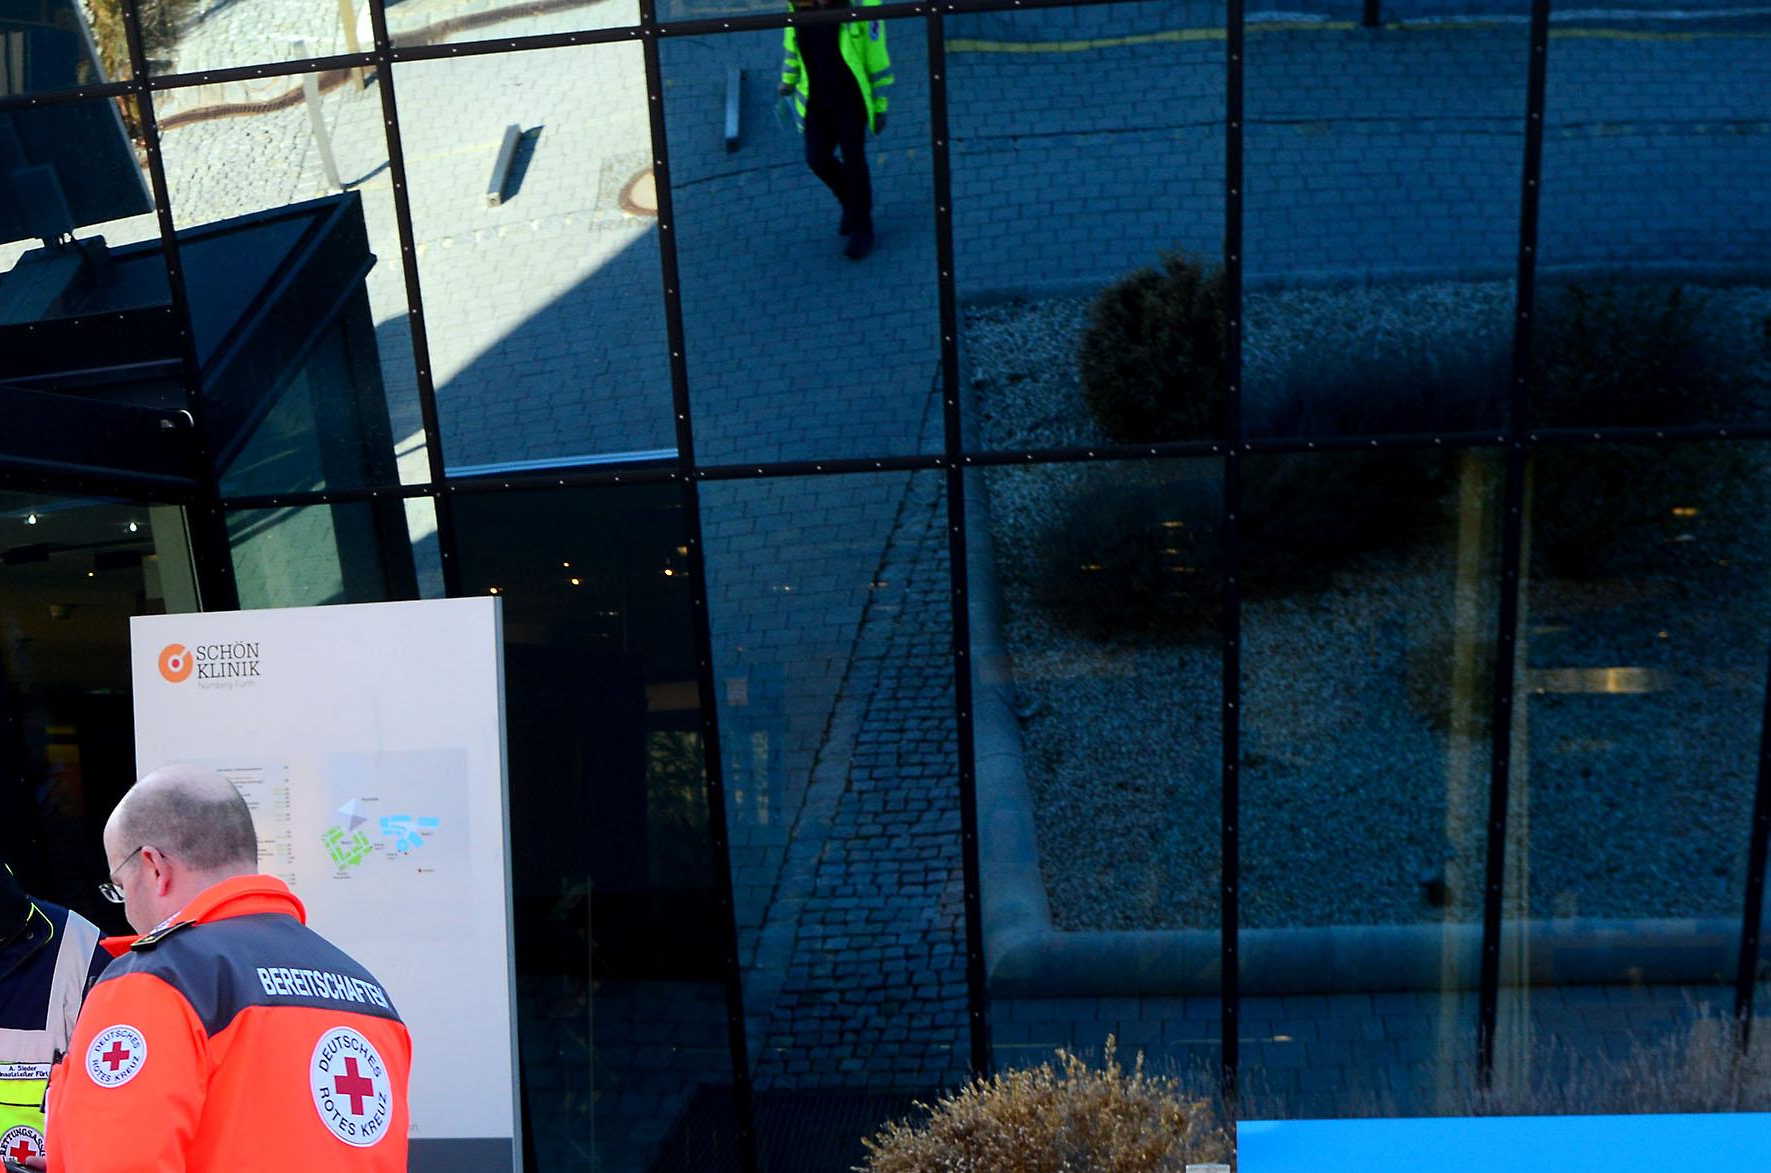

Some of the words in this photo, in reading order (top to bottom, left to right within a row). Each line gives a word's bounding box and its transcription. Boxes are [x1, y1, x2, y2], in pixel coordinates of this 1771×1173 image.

[196, 641, 259, 661] SCHÖN
[197, 661, 260, 679] KLINIK
[95, 1030, 140, 1052] DEUTSCHES
[319, 1035, 382, 1078] DEUTSCHES
[92, 1059, 111, 1082] ROTES
[115, 1056, 141, 1082] KREUZ
[319, 1086, 356, 1136] ROTES
[360, 1092, 388, 1137] KREUZ
